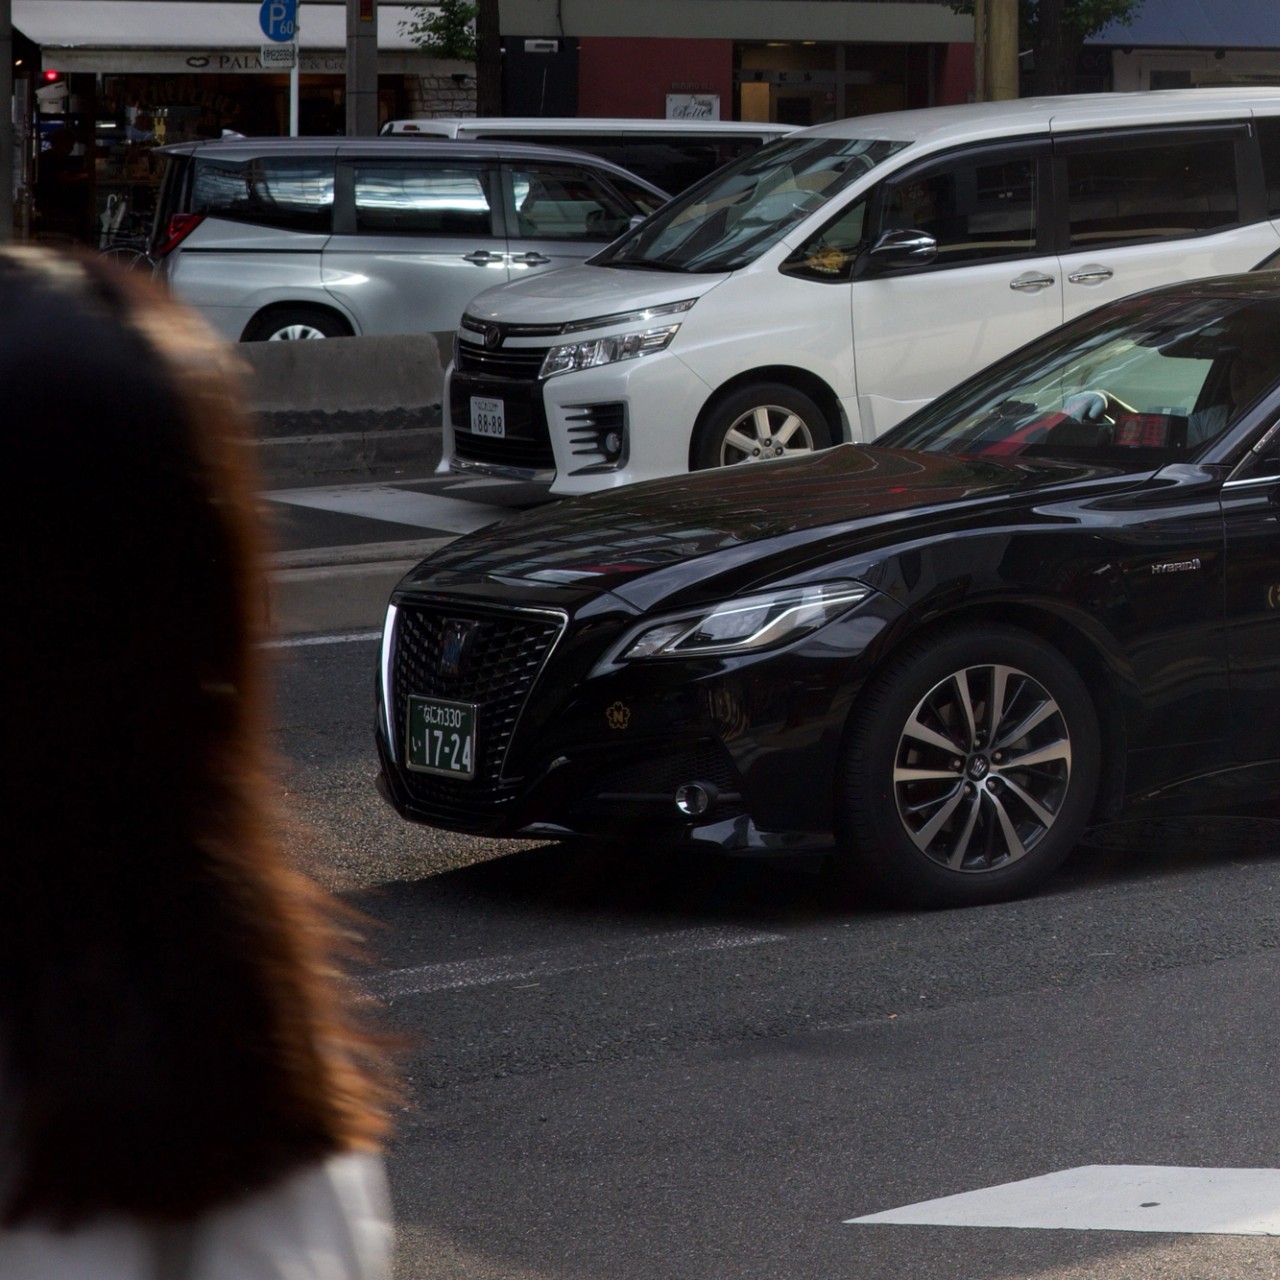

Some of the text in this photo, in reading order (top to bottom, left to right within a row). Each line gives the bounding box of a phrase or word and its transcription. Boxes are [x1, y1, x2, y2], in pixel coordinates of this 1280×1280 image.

[279, 20, 294, 34] 60
[477, 412, 503, 435] 88-88
[1151, 561, 1193, 574] HYBRID
[423, 704, 462, 728] なにわ330
[425, 728, 471, 773] 17-24
